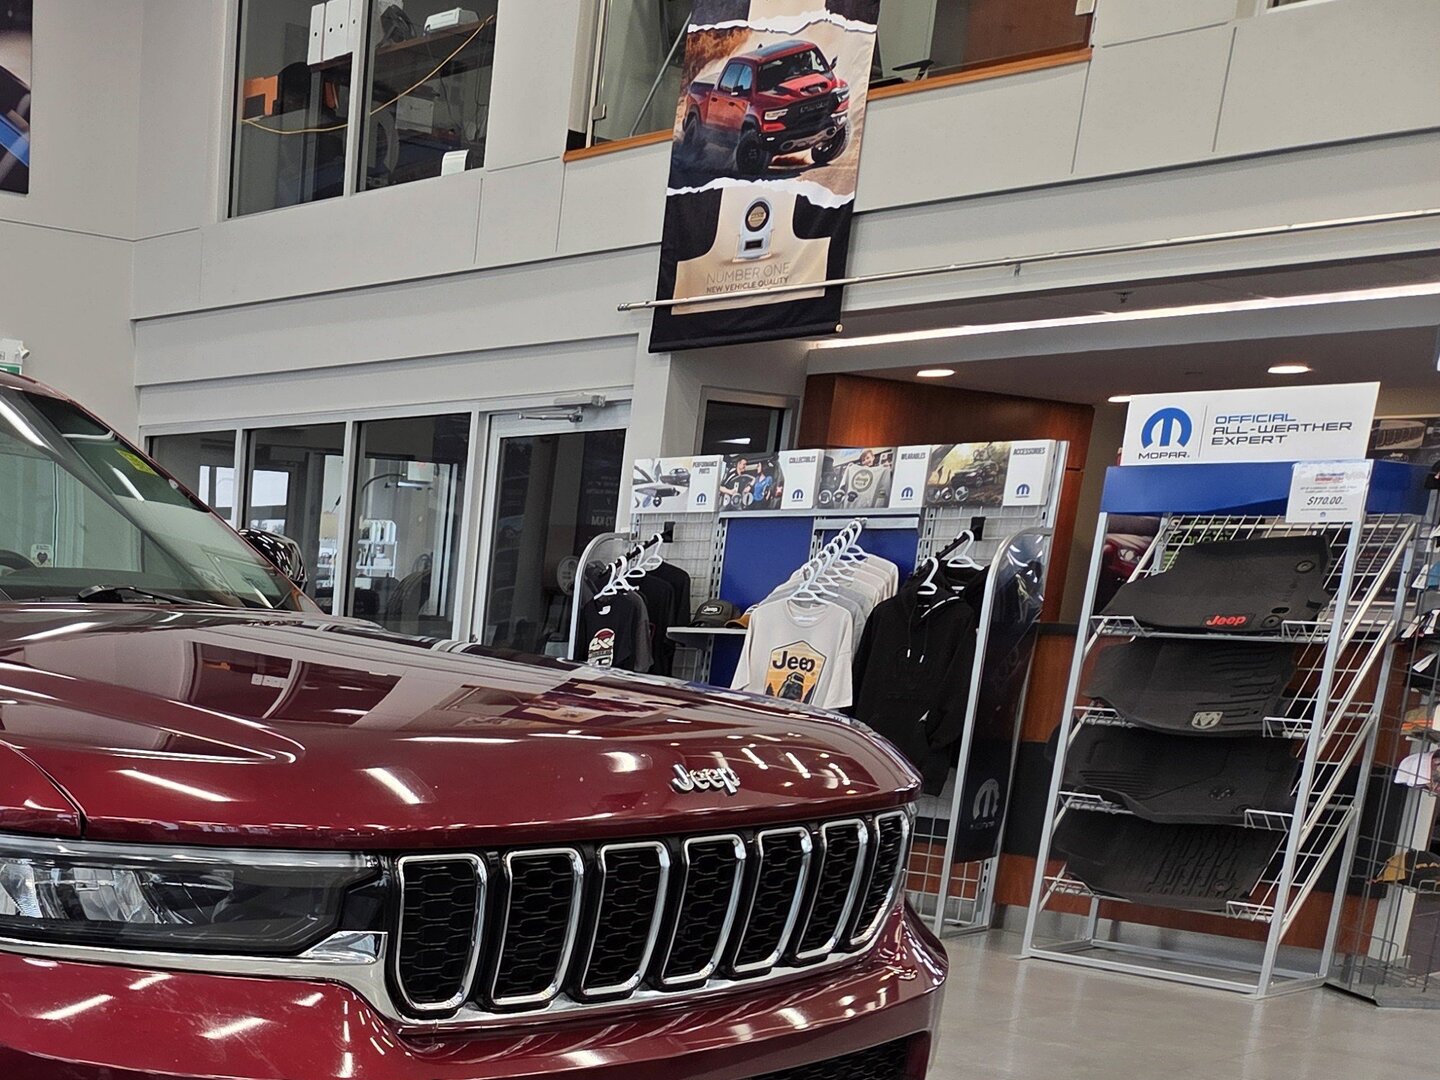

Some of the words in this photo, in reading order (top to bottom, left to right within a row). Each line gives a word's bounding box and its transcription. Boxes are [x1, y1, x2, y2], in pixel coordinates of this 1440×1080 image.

[707, 267, 760, 283] NUMBER
[763, 262, 790, 276] ONE
[706, 285, 723, 294] NEW
[725, 281, 756, 292] VEHICLE
[759, 276, 790, 287] QUALITY
[1215, 413, 1297, 425] OFFICIAL
[1212, 421, 1353, 435] ALL-WEATHER
[1211, 434, 1288, 446] EXPERT
[1206, 614, 1247, 626] Jeep
[772, 650, 816, 673] Jeep
[673, 764, 741, 794] Jeep
